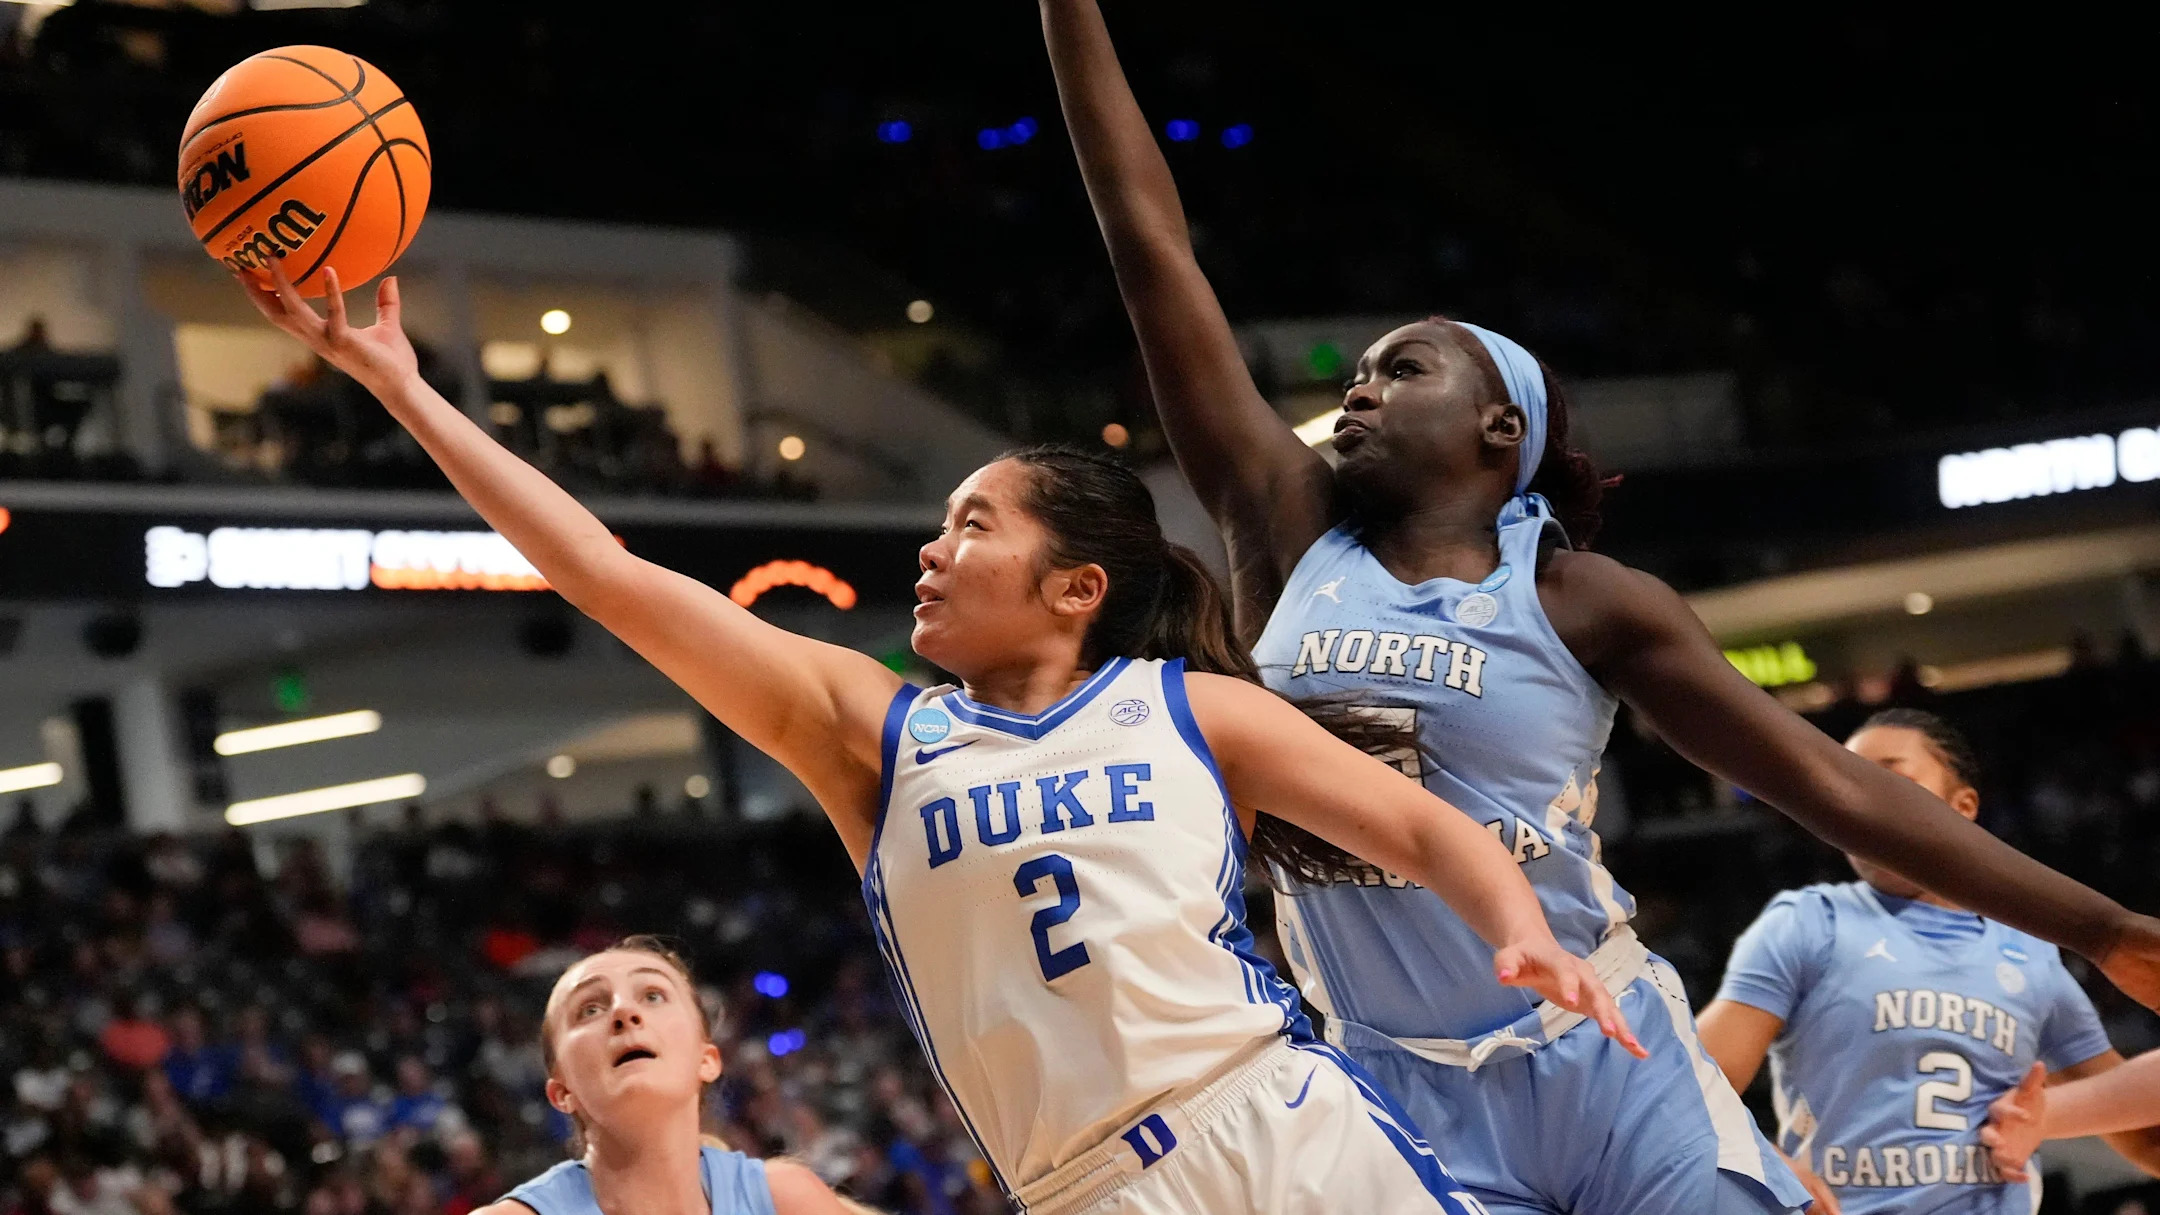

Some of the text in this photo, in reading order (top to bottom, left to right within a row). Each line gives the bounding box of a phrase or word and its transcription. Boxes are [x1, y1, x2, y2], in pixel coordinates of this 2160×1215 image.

[223, 199, 327, 272] Wilso
[1291, 629, 1488, 698] NORTH
[913, 722, 949, 734] NCAA
[1115, 704, 1147, 716] ACC
[919, 763, 1155, 870] DUKE
[1013, 853, 1091, 983] 2
[1873, 989, 2018, 1057] NORTH
[1914, 1051, 1973, 1132] 2
[1822, 1144, 2001, 1188] CAROLIN
